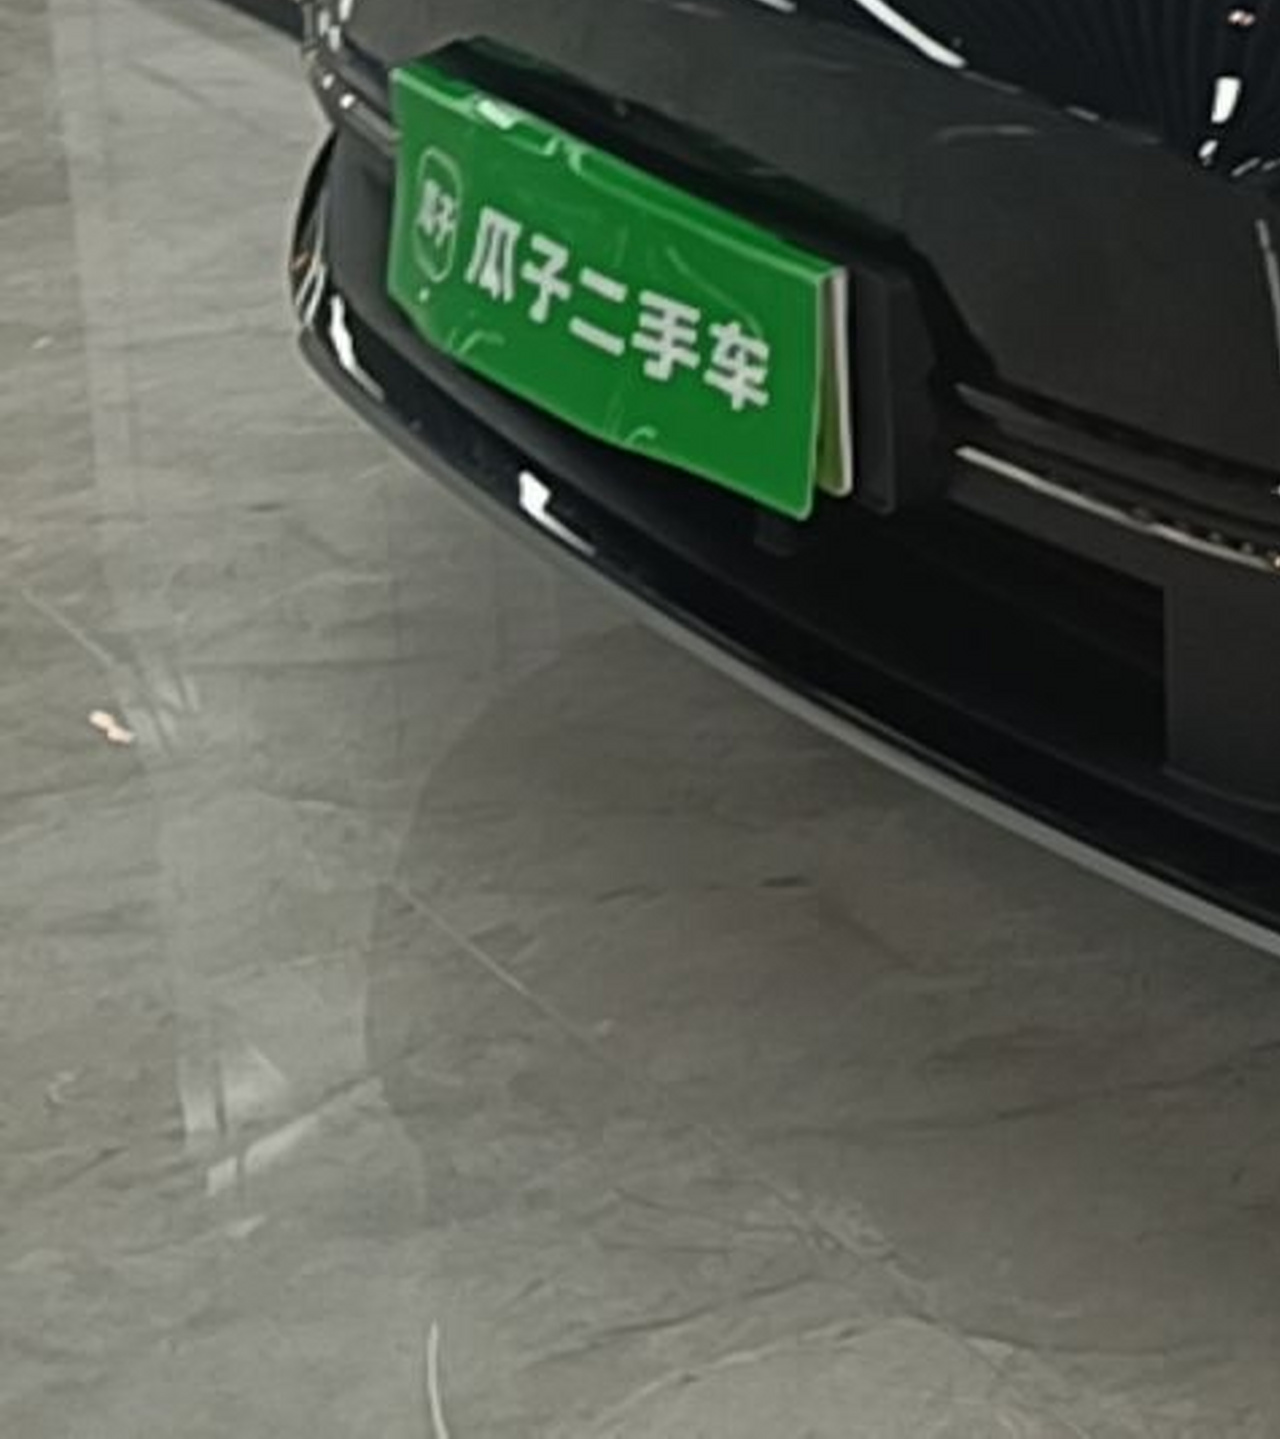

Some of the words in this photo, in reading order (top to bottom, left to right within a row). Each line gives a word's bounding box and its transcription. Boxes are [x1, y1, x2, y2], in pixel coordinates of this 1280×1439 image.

[464, 206, 770, 412] 瓜子二手车
